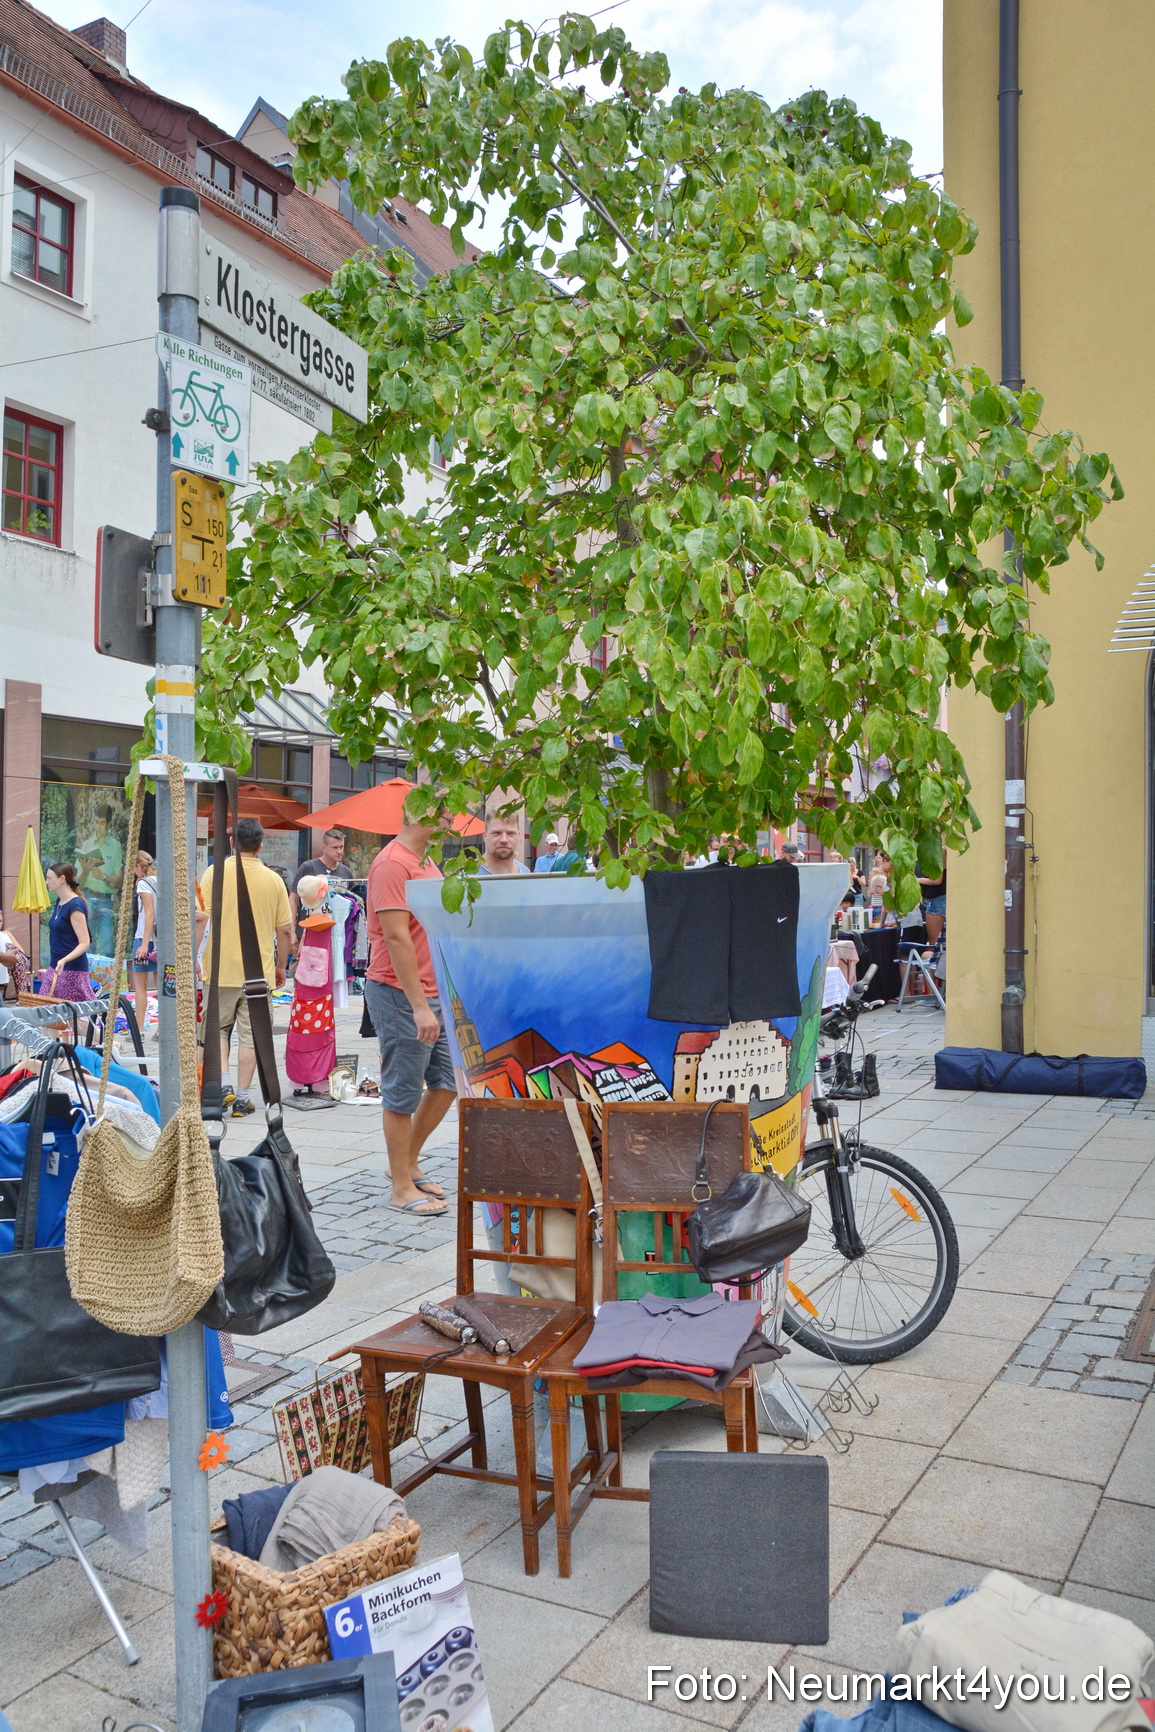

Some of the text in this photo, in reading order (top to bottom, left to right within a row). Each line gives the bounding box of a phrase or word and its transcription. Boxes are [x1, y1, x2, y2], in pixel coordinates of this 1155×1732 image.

[216, 255, 355, 394] Klostergasse
[188, 348, 243, 379] Richtungen
[214, 335, 231, 356] Gasse
[233, 350, 246, 364] zum
[194, 453, 214, 465] JURA
[181, 500, 193, 527] S
[207, 518, 224, 538] 150
[368, 1570, 442, 1610] Minikuchen
[371, 1591, 432, 1625] Backform
[373, 1614, 408, 1635] Für Donuts
